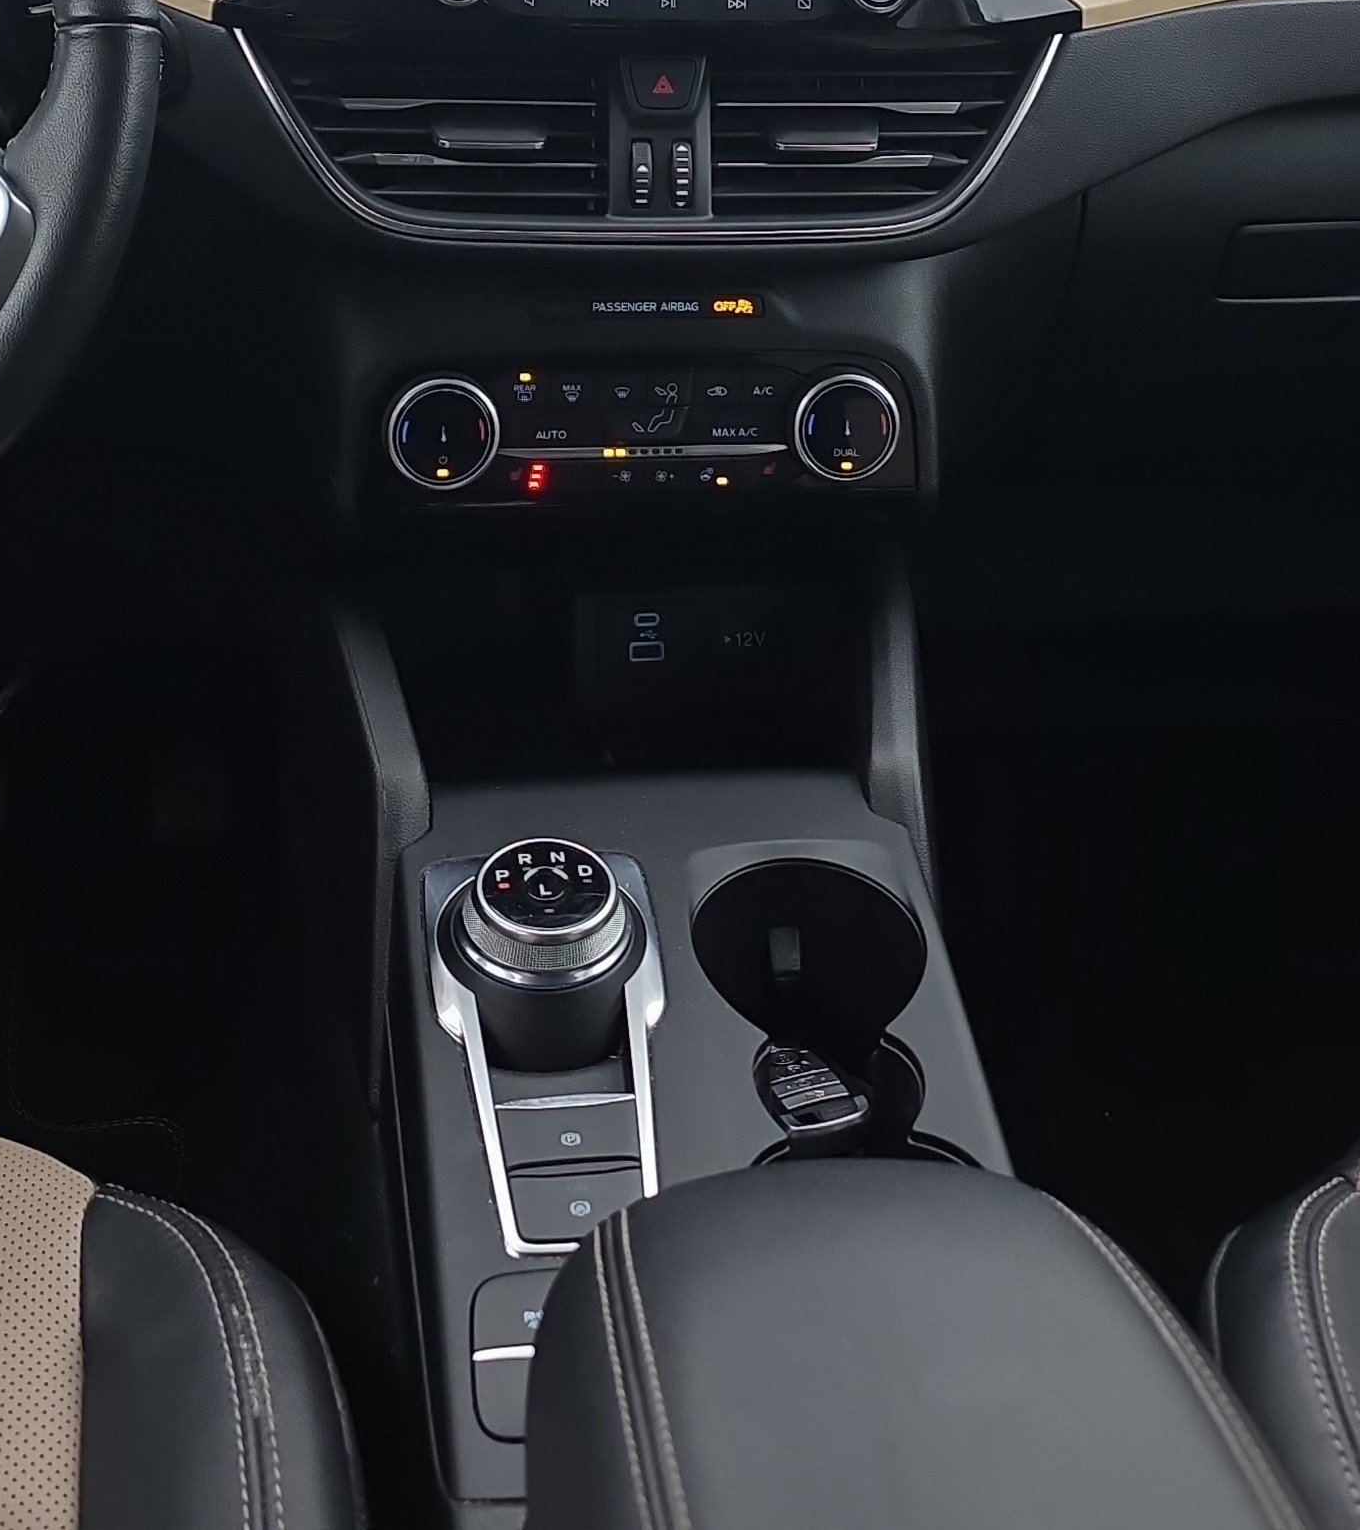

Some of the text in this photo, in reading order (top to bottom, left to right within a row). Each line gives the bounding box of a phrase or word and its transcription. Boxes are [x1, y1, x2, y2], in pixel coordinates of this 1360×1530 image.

[592, 300, 736, 312] PASSENGER AIRBAG OFF
[513, 384, 537, 392] REAR
[752, 385, 774, 396] A/C
[535, 429, 568, 440] AUTO
[712, 427, 759, 437] MAX A/C
[833, 448, 860, 458] DUAL
[735, 630, 767, 648] 12V
[495, 851, 593, 882] P R N D
[539, 883, 553, 896] L
